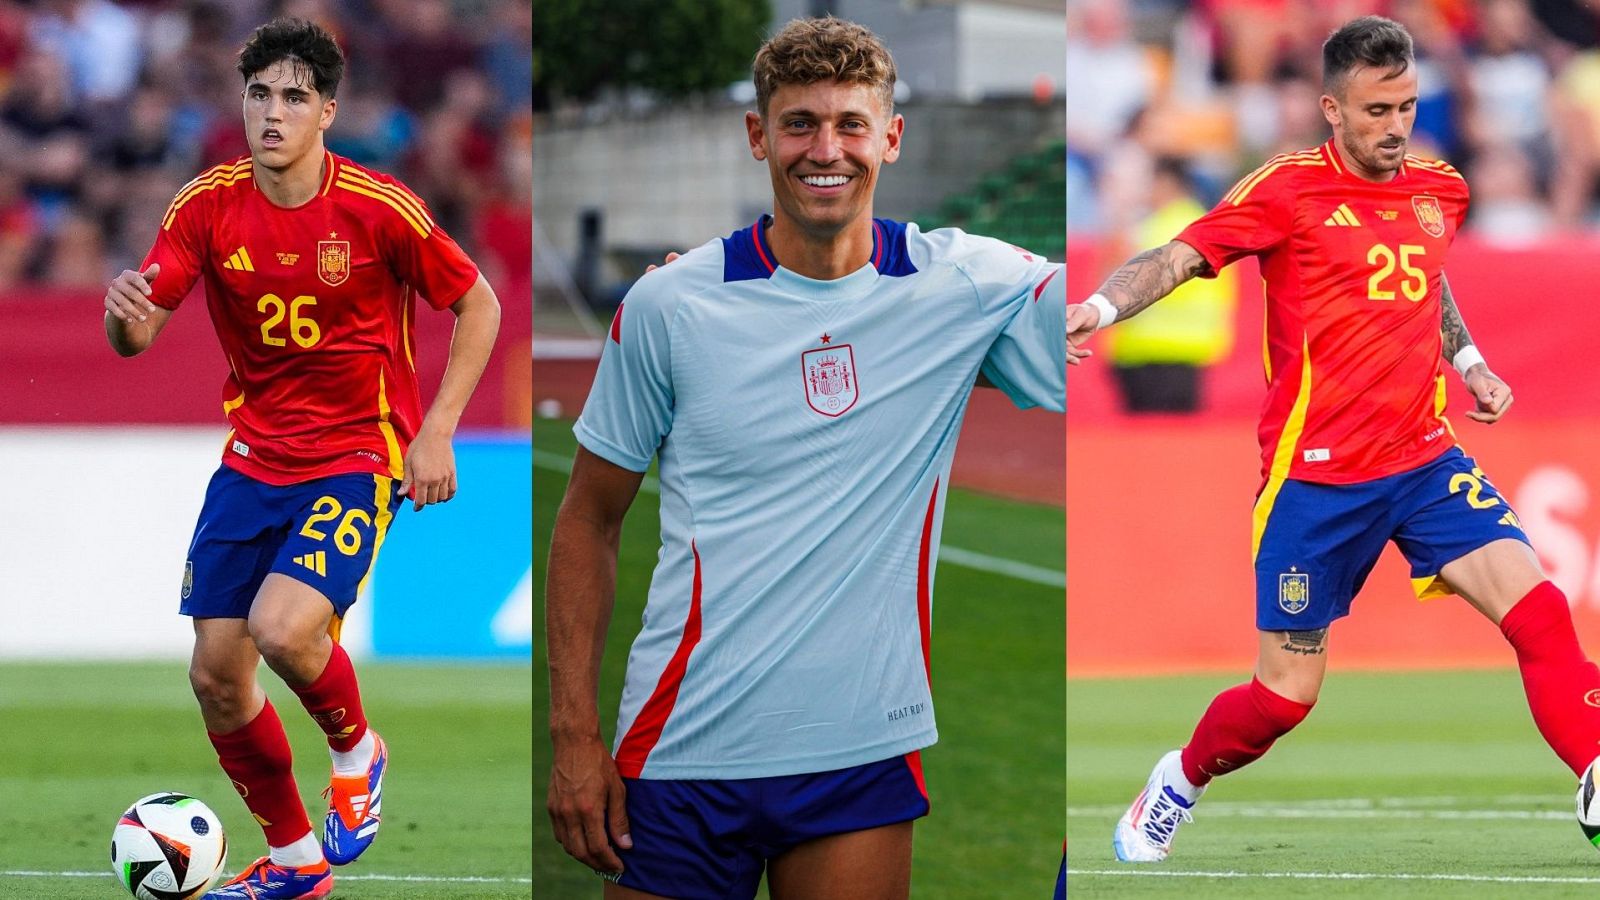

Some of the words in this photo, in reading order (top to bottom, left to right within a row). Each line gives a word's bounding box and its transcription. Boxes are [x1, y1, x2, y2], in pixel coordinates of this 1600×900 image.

[1367, 244, 1428, 302] 25
[257, 294, 320, 348] 26
[299, 496, 371, 556] 26
